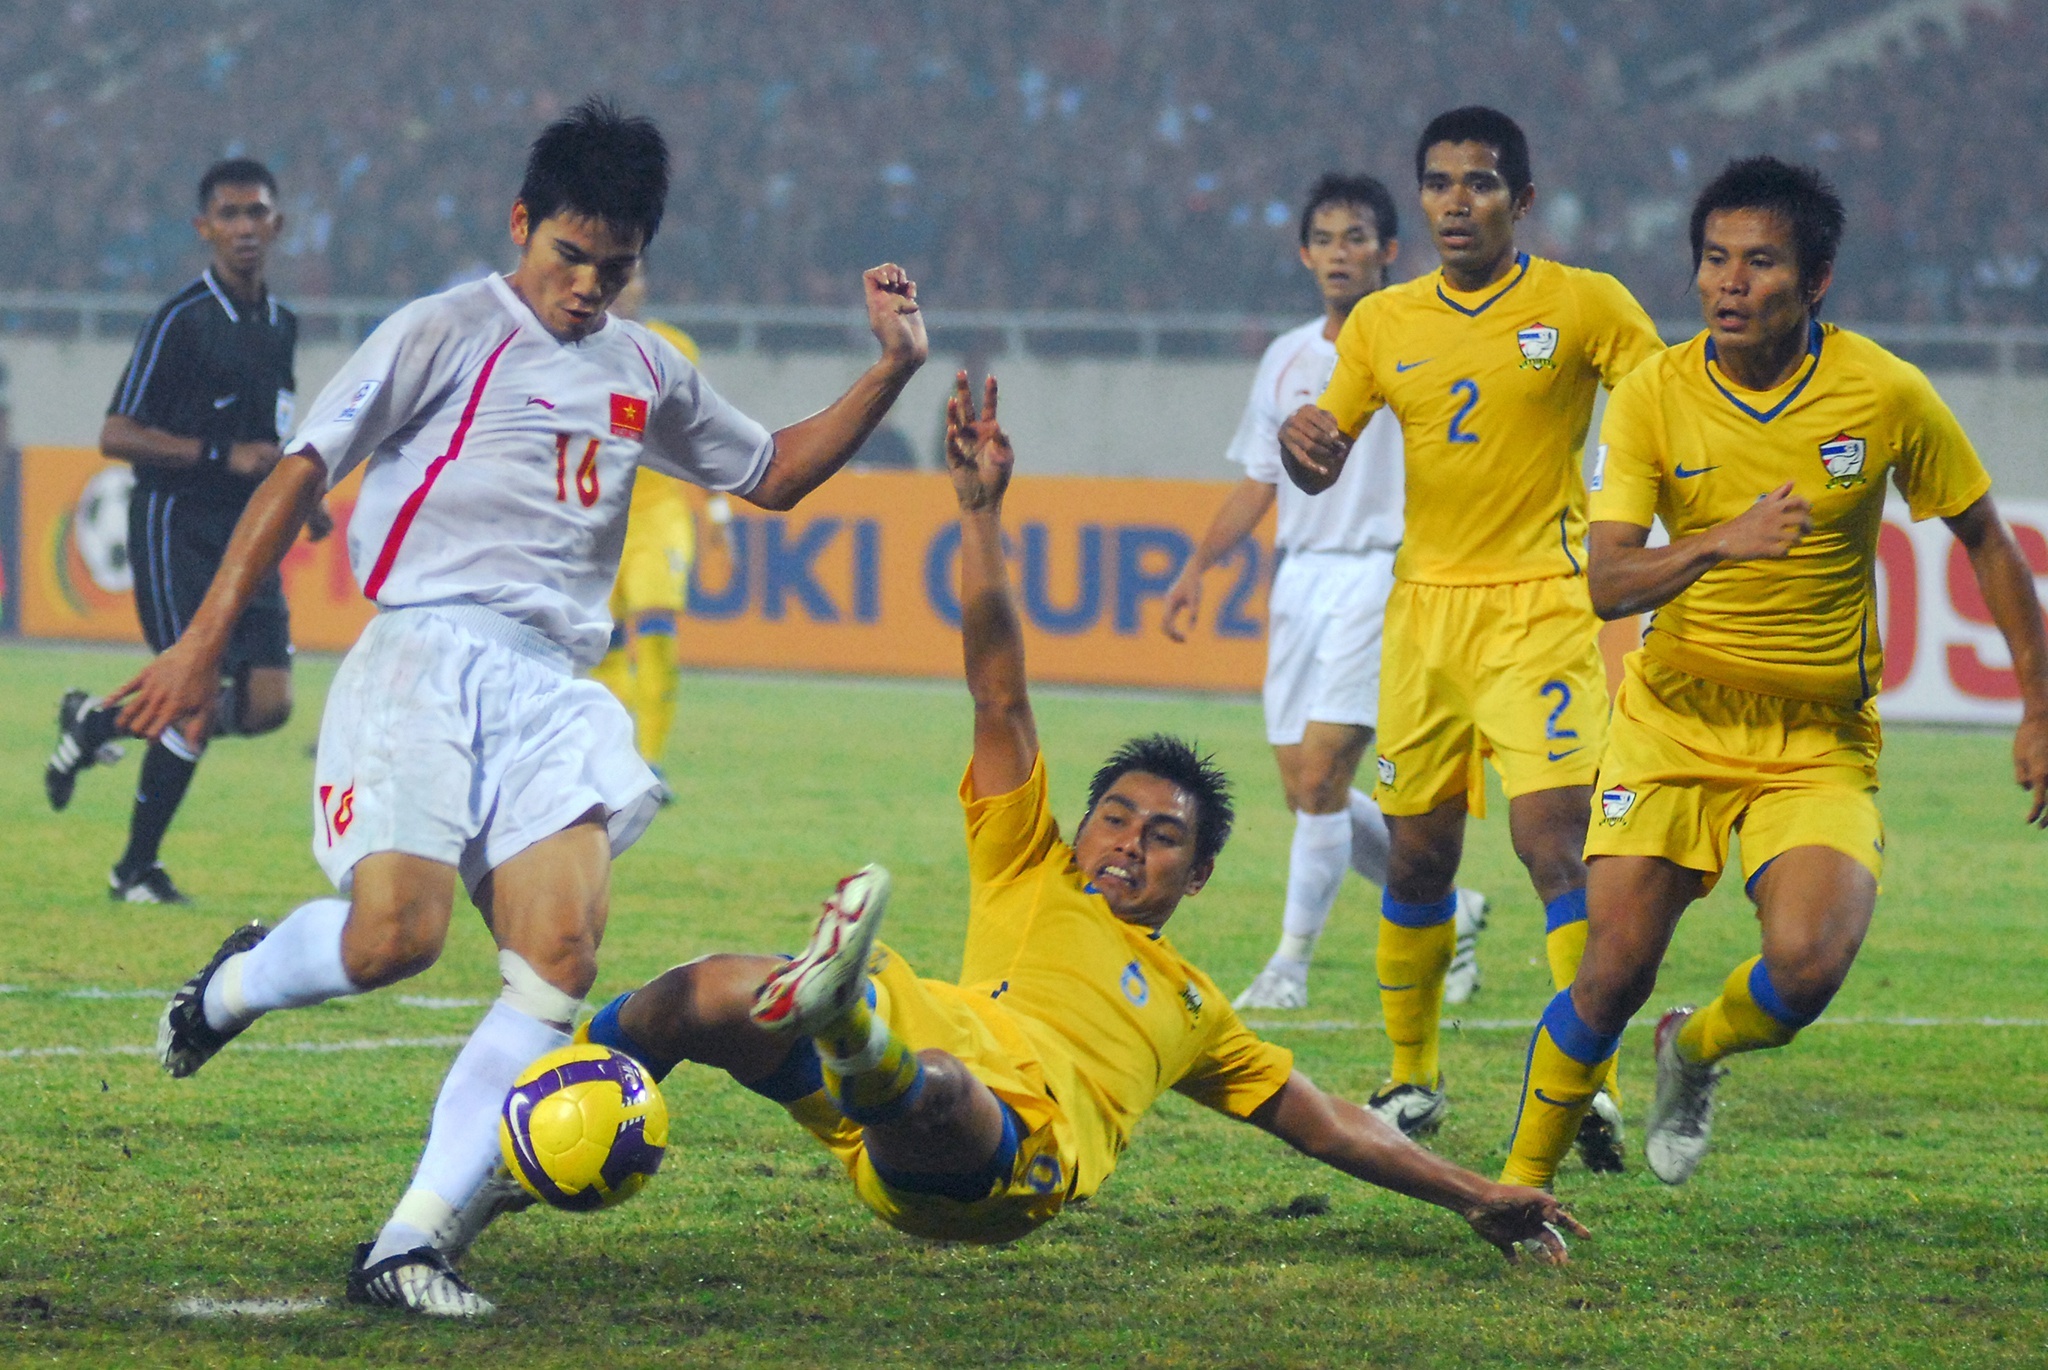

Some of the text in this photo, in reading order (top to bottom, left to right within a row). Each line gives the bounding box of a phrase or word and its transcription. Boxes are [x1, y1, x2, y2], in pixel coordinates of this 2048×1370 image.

[1448, 378, 1480, 442] 2
[555, 432, 600, 508] 16
[685, 515, 1284, 637] UKI CUP 2
[1540, 679, 1579, 740] 2
[319, 776, 355, 848] 16
